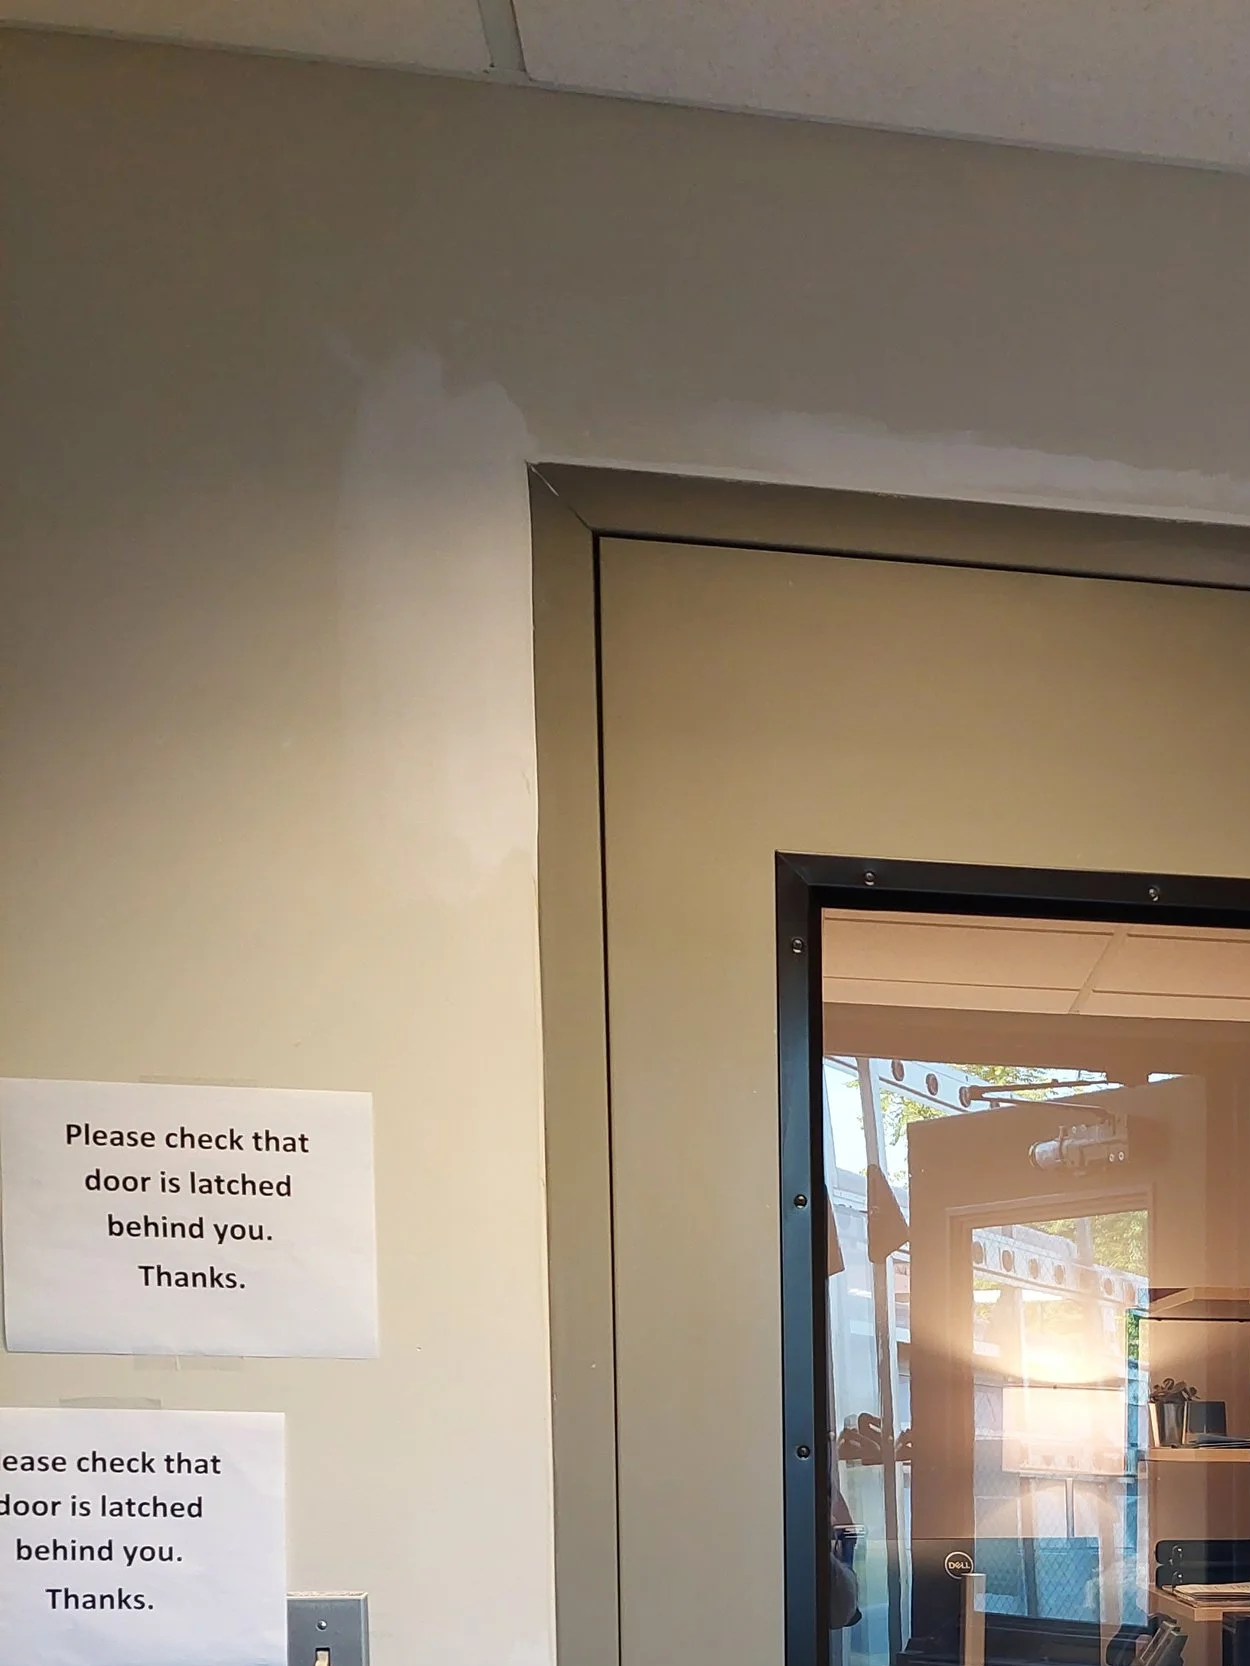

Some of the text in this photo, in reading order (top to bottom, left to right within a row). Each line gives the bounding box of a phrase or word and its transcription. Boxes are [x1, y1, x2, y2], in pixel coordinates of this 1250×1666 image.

[66, 1122, 309, 1153] Please check that
[84, 1168, 292, 1197] door is latched
[107, 1213, 273, 1245] behind you.
[138, 1264, 246, 1289] Thanks.
[1, 1450, 221, 1475] ease check that
[0, 1493, 203, 1518] door is latched
[16, 1538, 182, 1567] behind you.
[948, 1561, 971, 1569] DELL
[46, 1587, 154, 1610] Thanks.
